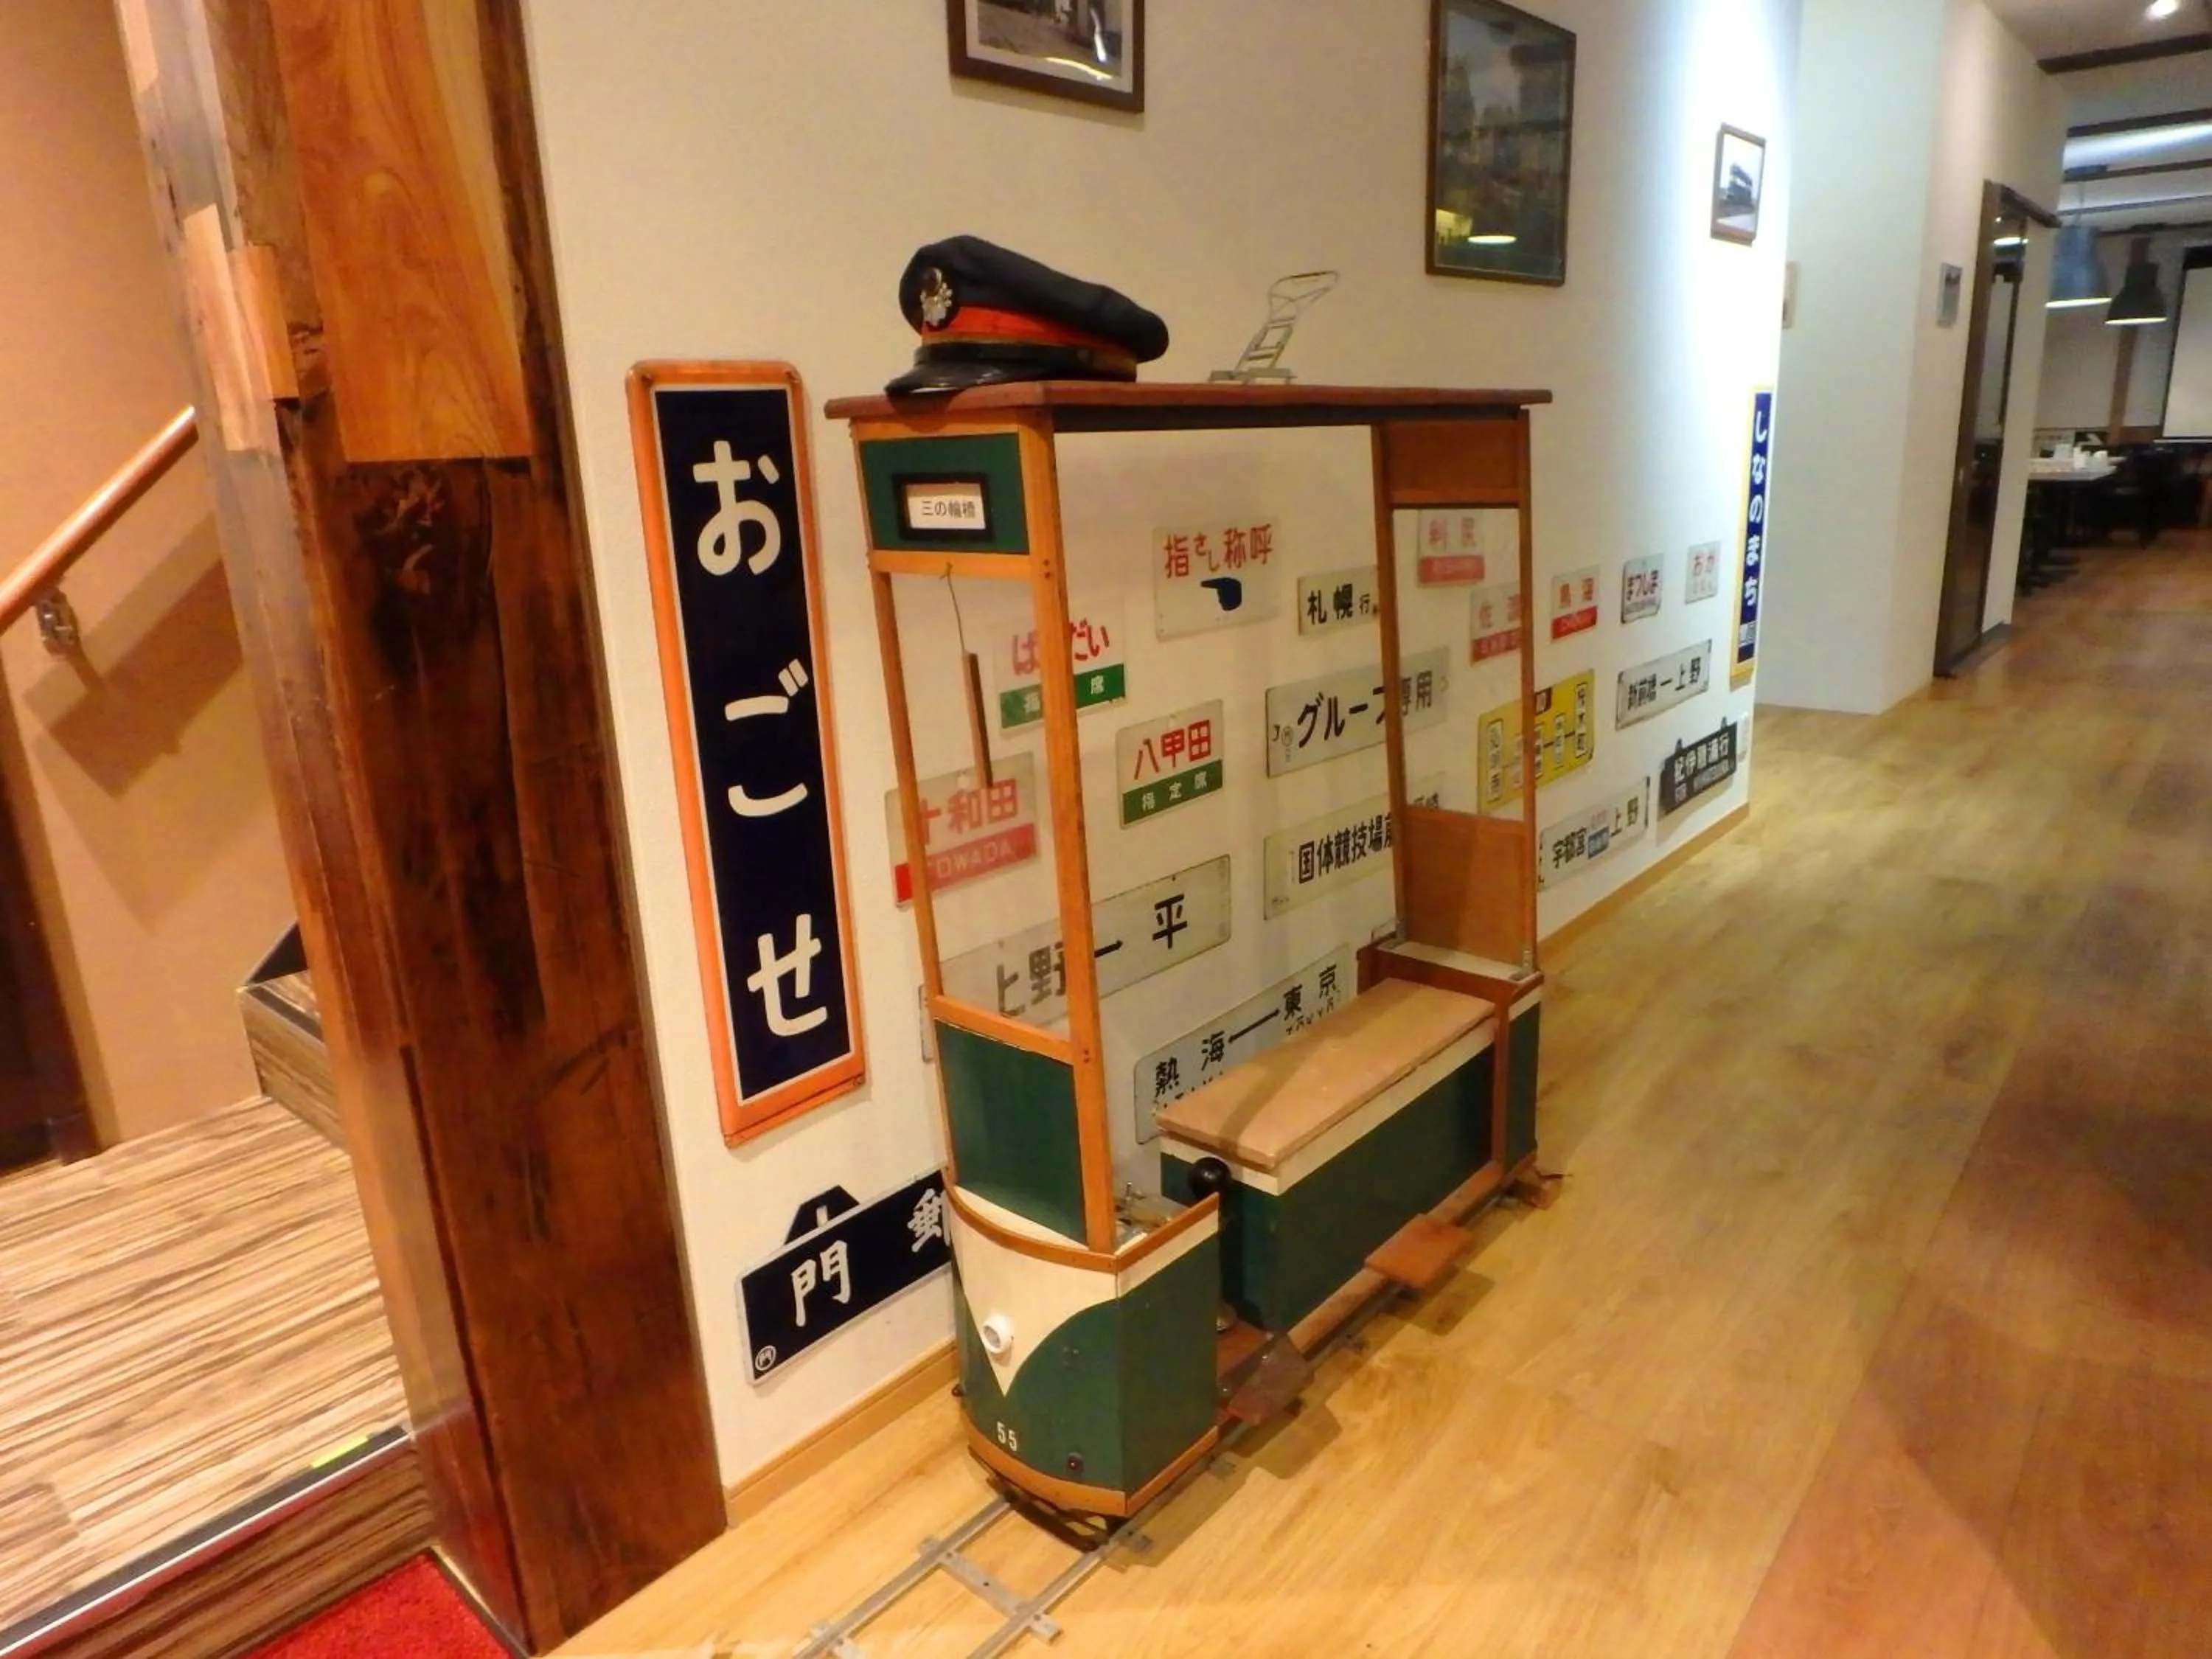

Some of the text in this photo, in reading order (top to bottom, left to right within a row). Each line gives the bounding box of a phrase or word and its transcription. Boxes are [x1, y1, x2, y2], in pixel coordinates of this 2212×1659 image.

[1745, 411, 1768, 607] しなのまち
[692, 439, 828, 1037] おごせ
[1134, 719, 1211, 780] 八甲田
[927, 838, 1016, 879] OWADA
[996, 1421, 1018, 1452] 55
